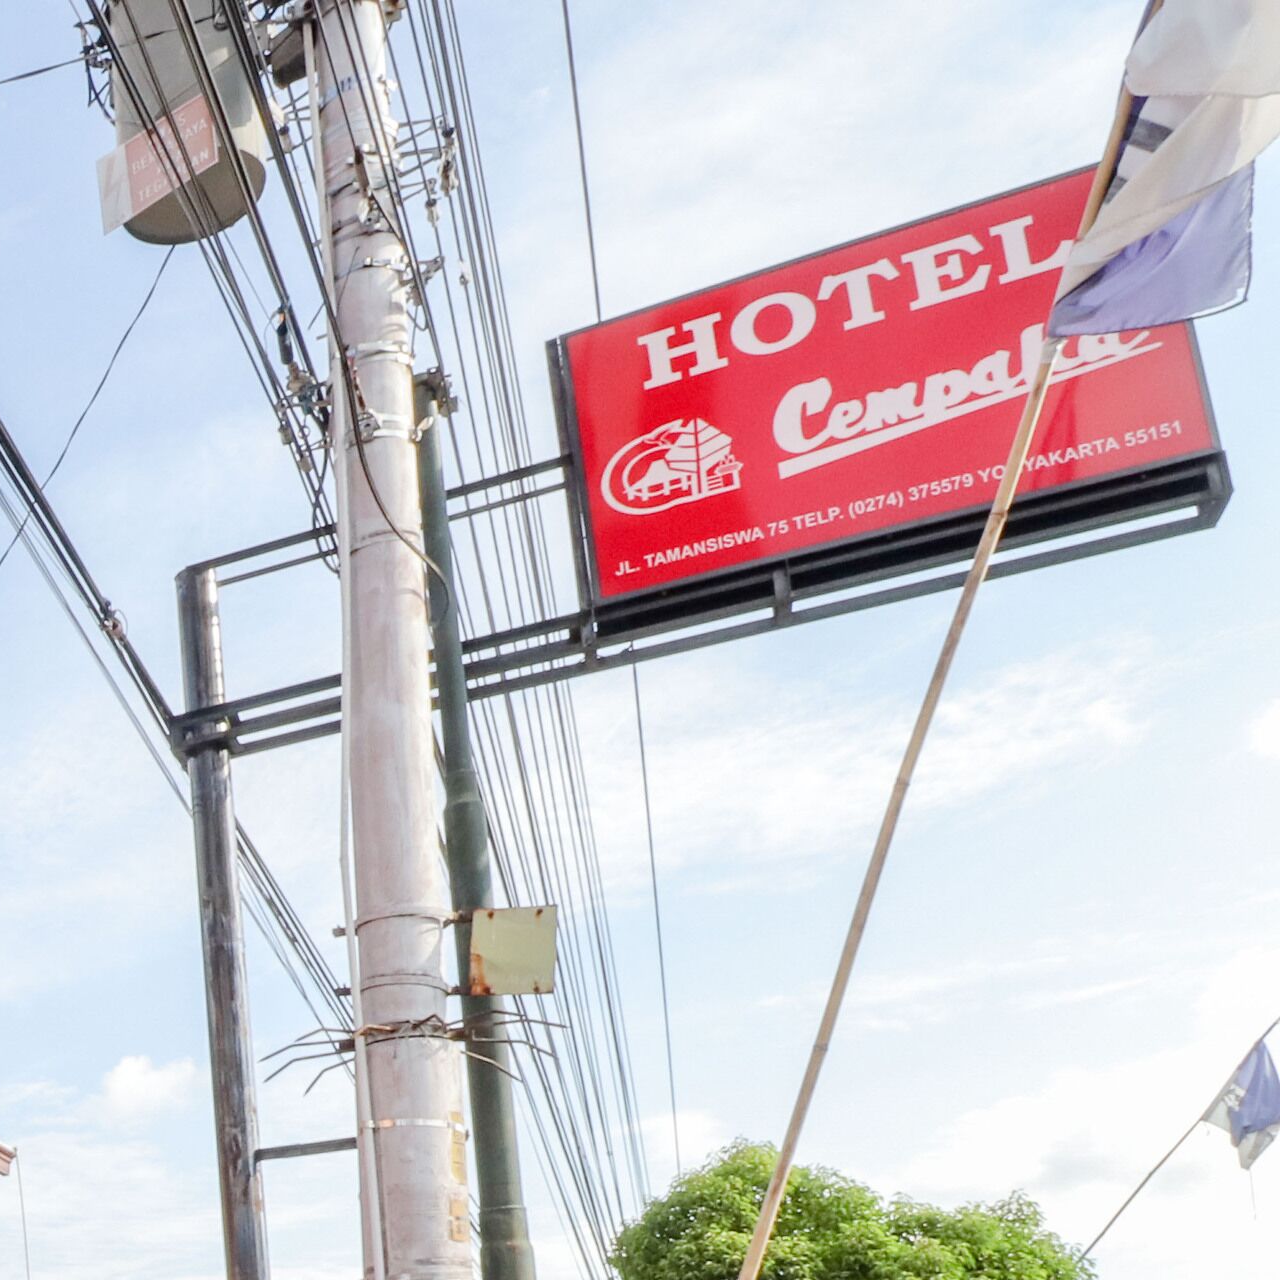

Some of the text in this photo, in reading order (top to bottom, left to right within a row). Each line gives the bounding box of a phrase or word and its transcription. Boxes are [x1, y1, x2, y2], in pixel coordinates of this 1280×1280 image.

[637, 214, 1075, 391] HOTEL
[614, 420, 1184, 577] JL. TAMANSISWA 75 TELP. (0274) 375579 YOYAKARTA 55151
